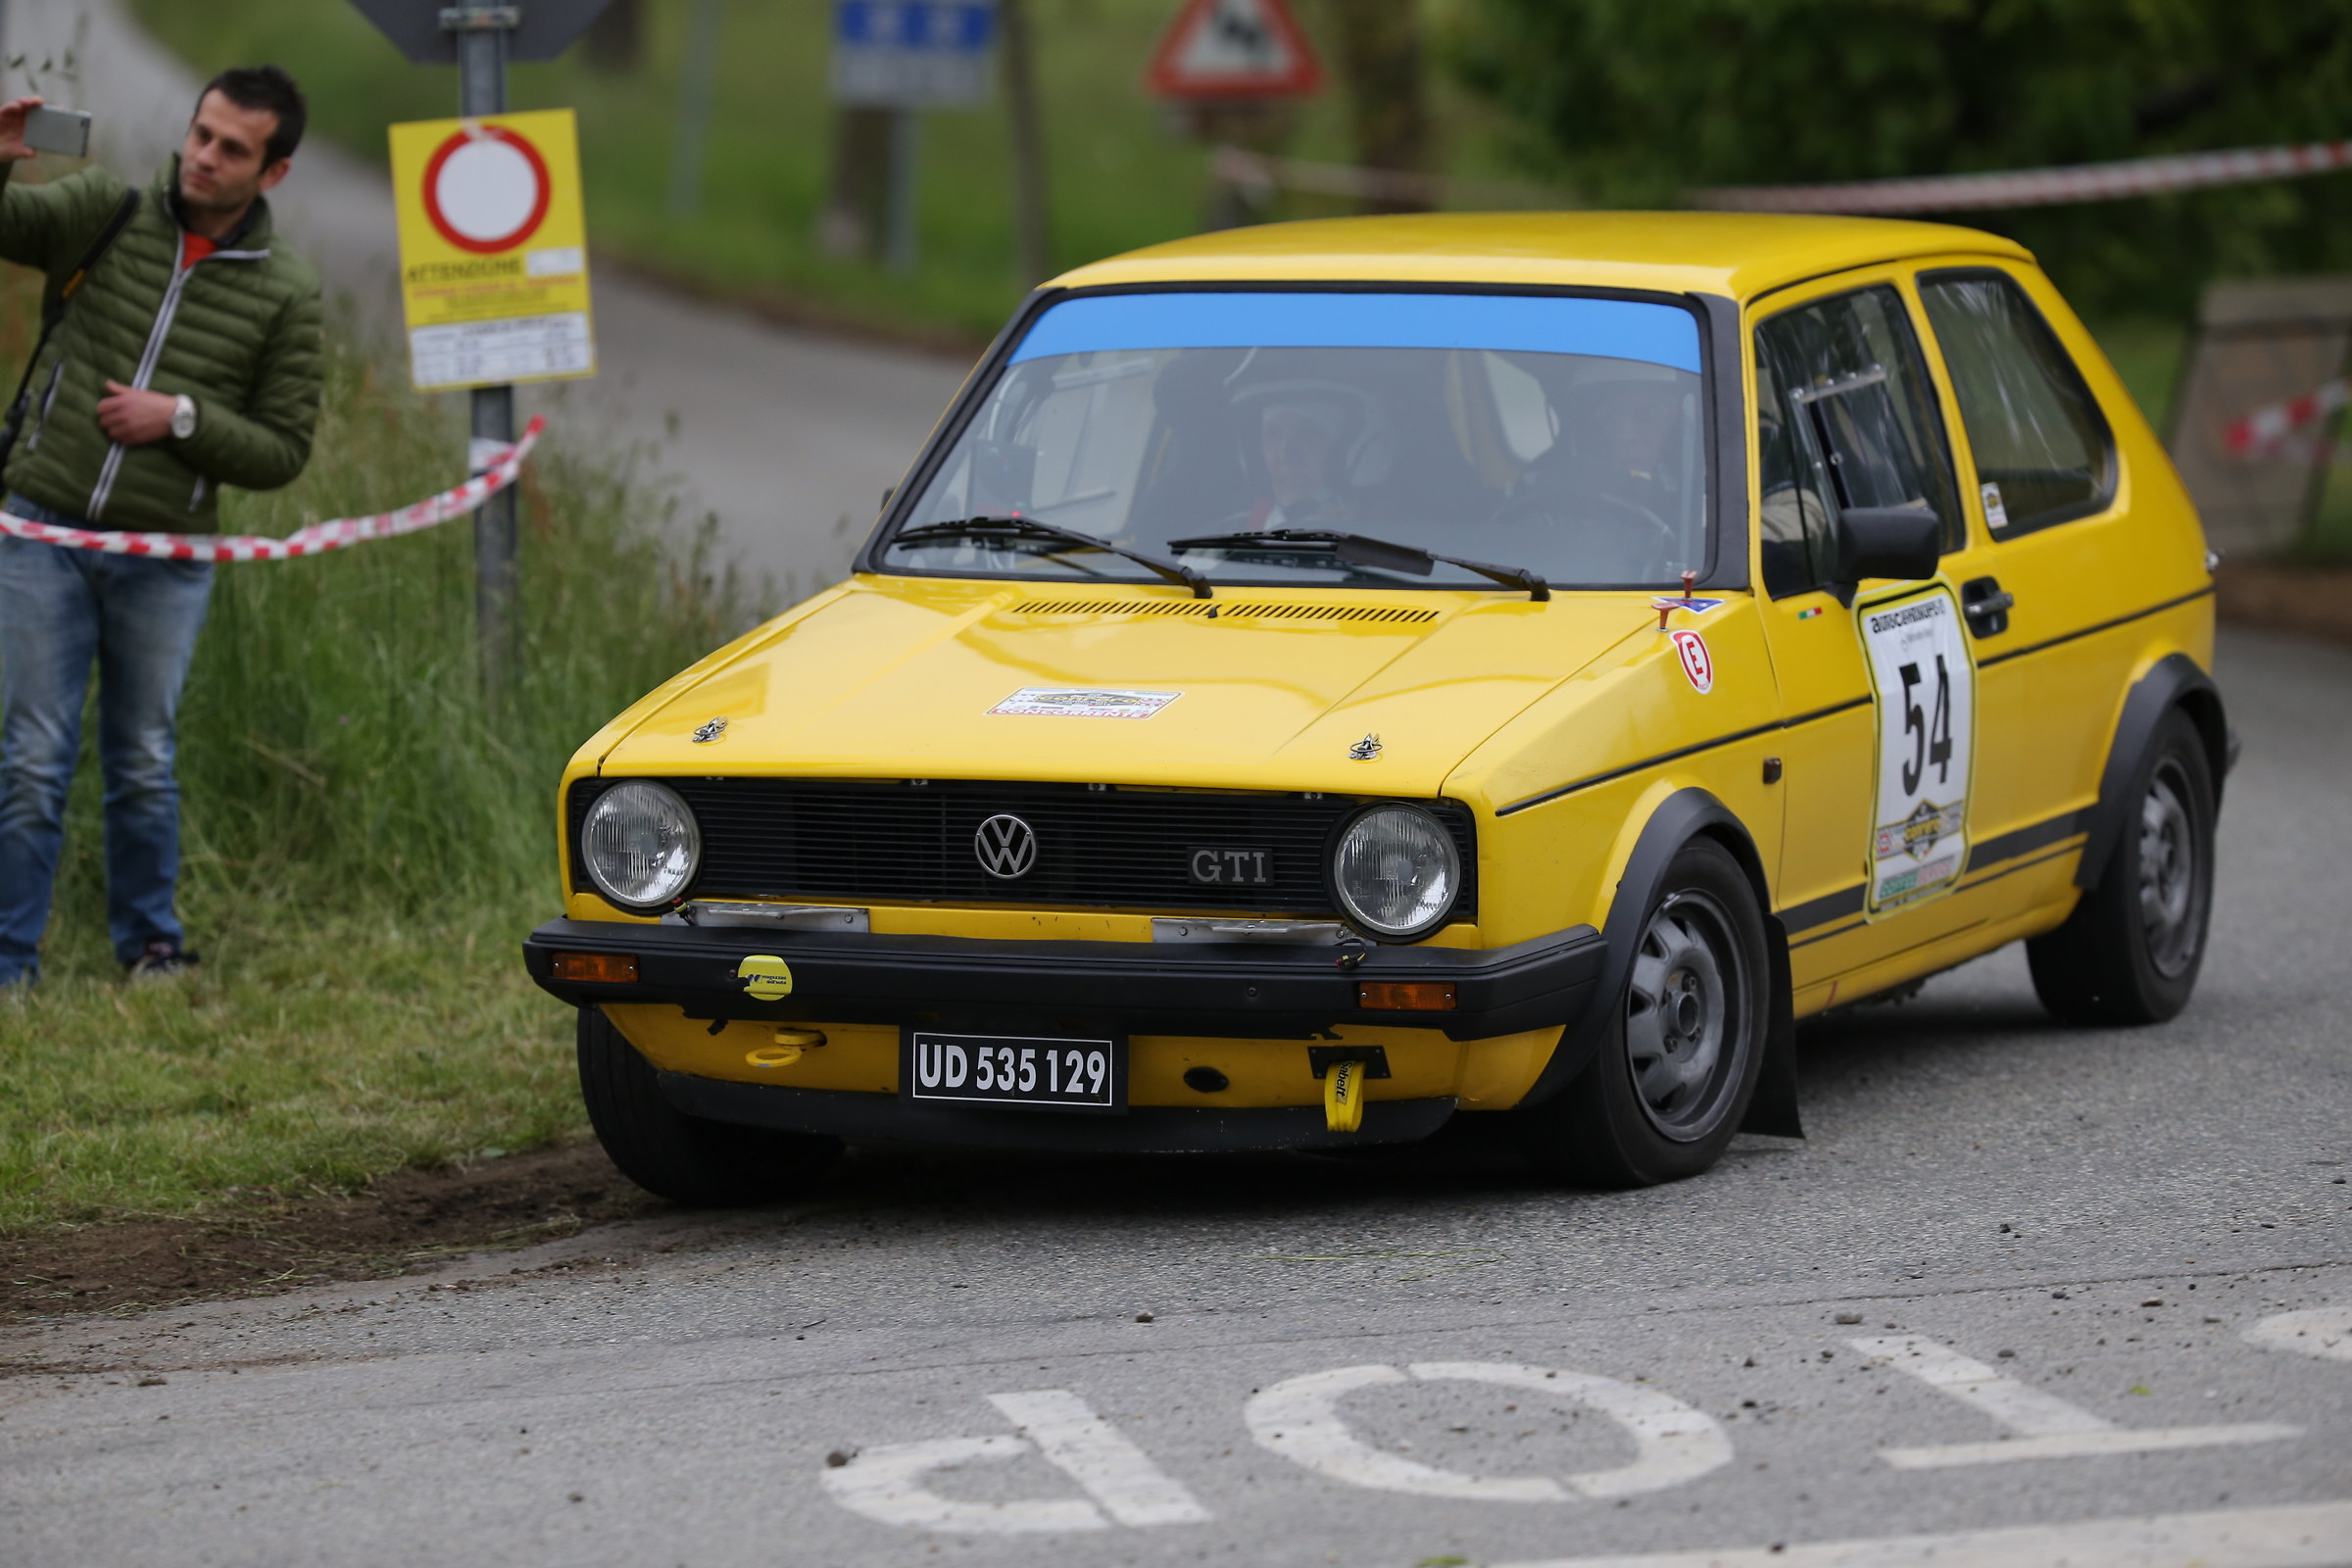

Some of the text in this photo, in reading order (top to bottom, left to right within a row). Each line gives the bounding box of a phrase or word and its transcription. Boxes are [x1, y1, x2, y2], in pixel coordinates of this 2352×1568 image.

[1686, 641, 1704, 675] E
[992, 709, 1149, 718] CONCORRENTE
[1898, 654, 1952, 796] 54
[1192, 850, 1266, 883] GTI
[919, 1044, 1105, 1094] UD 535 129
[1336, 1061, 1352, 1097] Sabelt
